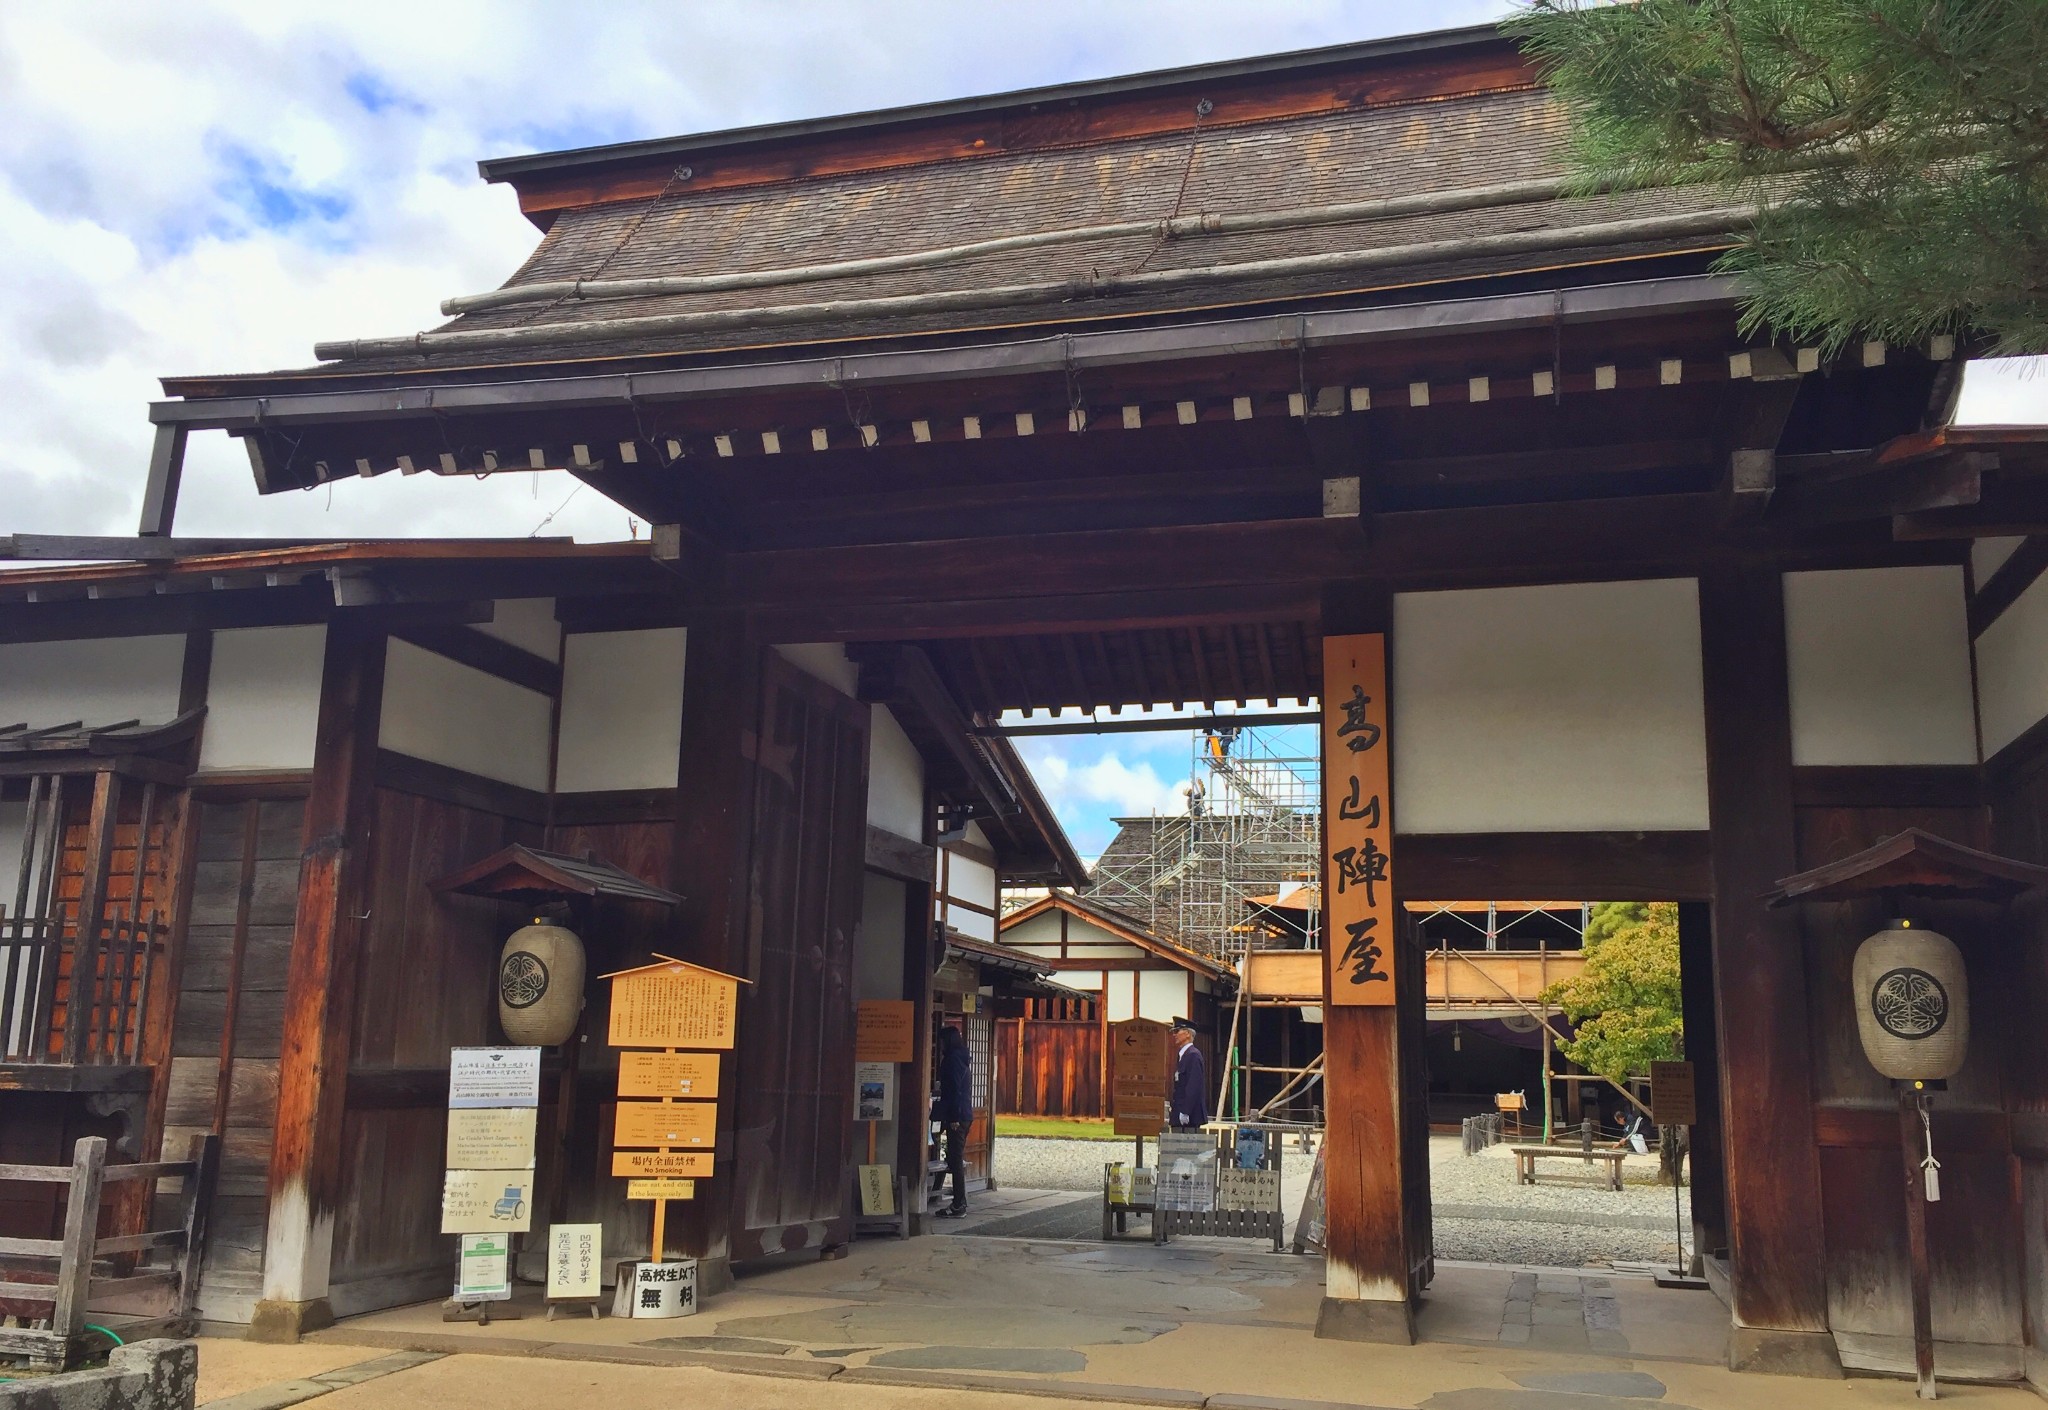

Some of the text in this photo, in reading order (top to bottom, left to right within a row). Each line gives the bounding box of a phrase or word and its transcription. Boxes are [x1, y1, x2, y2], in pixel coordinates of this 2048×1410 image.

[1335, 683, 1390, 986] 高山陣屋
[631, 1156, 696, 1166] 場内全面禁煙
[557, 1232, 570, 1286] 足元にご注意ください
[579, 1234, 592, 1284] 凹凸があります
[639, 1264, 697, 1283] 高校生以下
